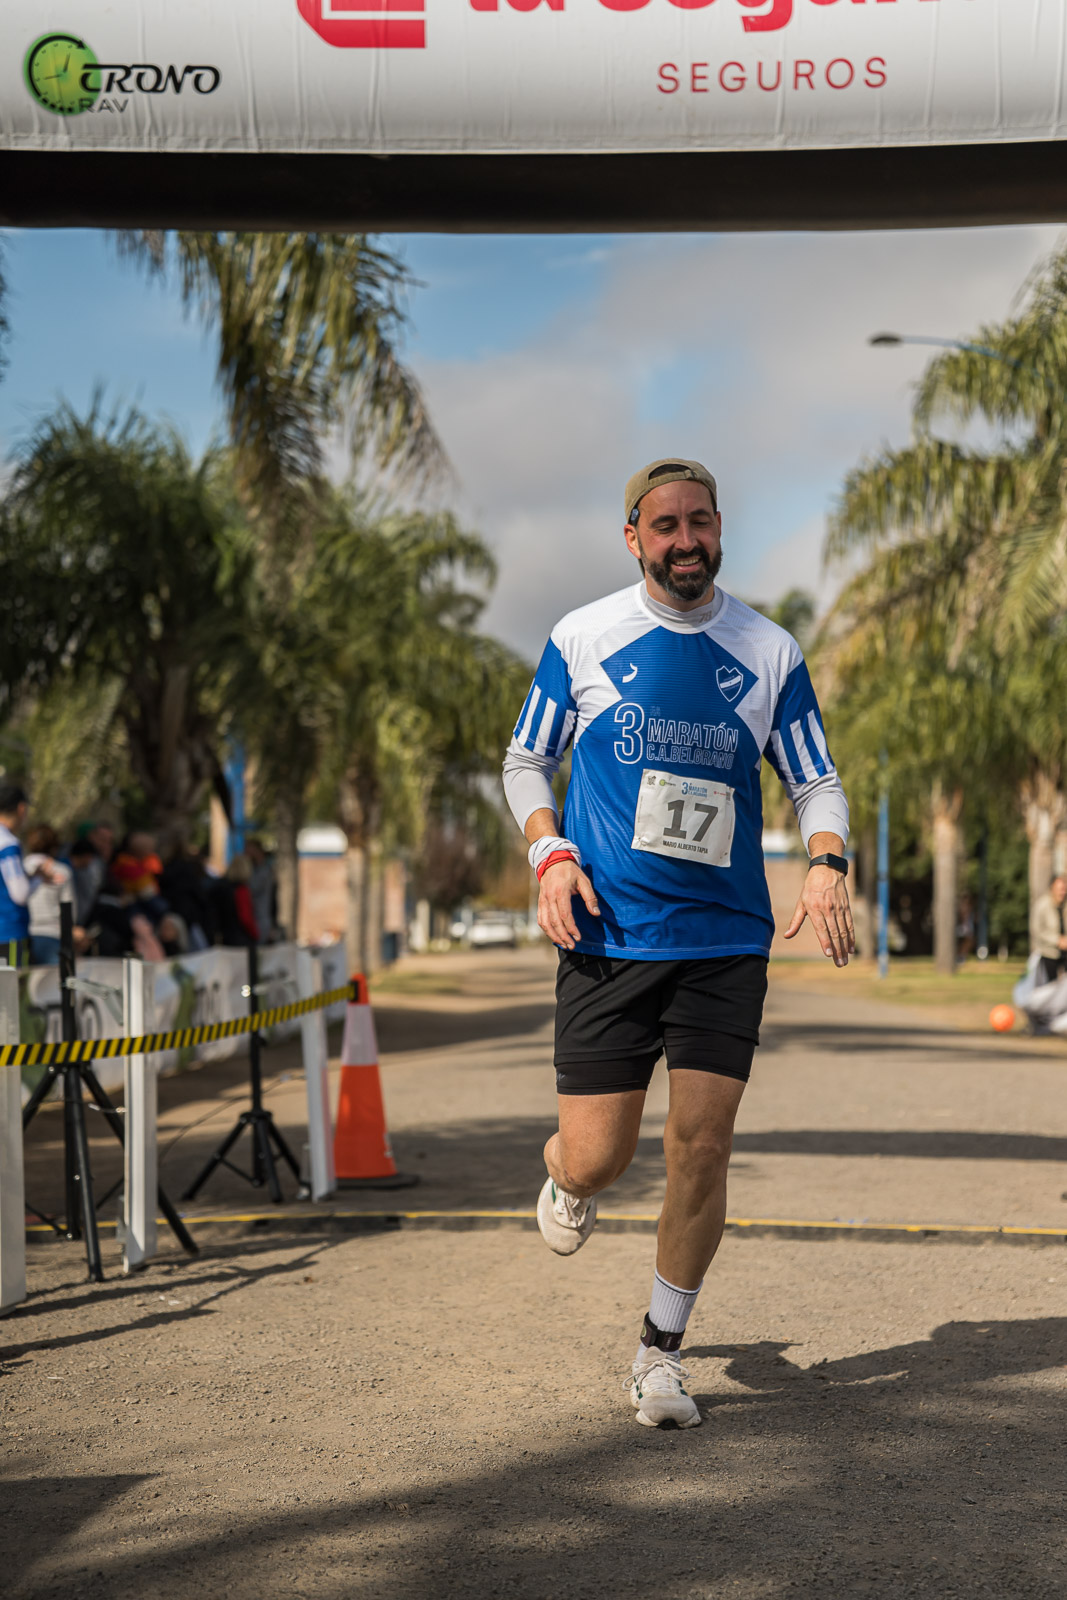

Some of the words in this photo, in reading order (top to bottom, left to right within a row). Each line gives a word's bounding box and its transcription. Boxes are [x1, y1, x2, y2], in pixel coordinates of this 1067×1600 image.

[80, 63, 220, 94] CRONO
[657, 56, 887, 94] SEGUROS
[79, 97, 129, 113] RAV
[614, 702, 645, 765] 3
[647, 718, 739, 753] MARATÓN
[681, 781, 689, 795] 3
[663, 799, 719, 842] 17
[662, 839, 678, 848] MARIO
[677, 842, 697, 852] ALBERTO
[697, 845, 709, 854] TAPIA
